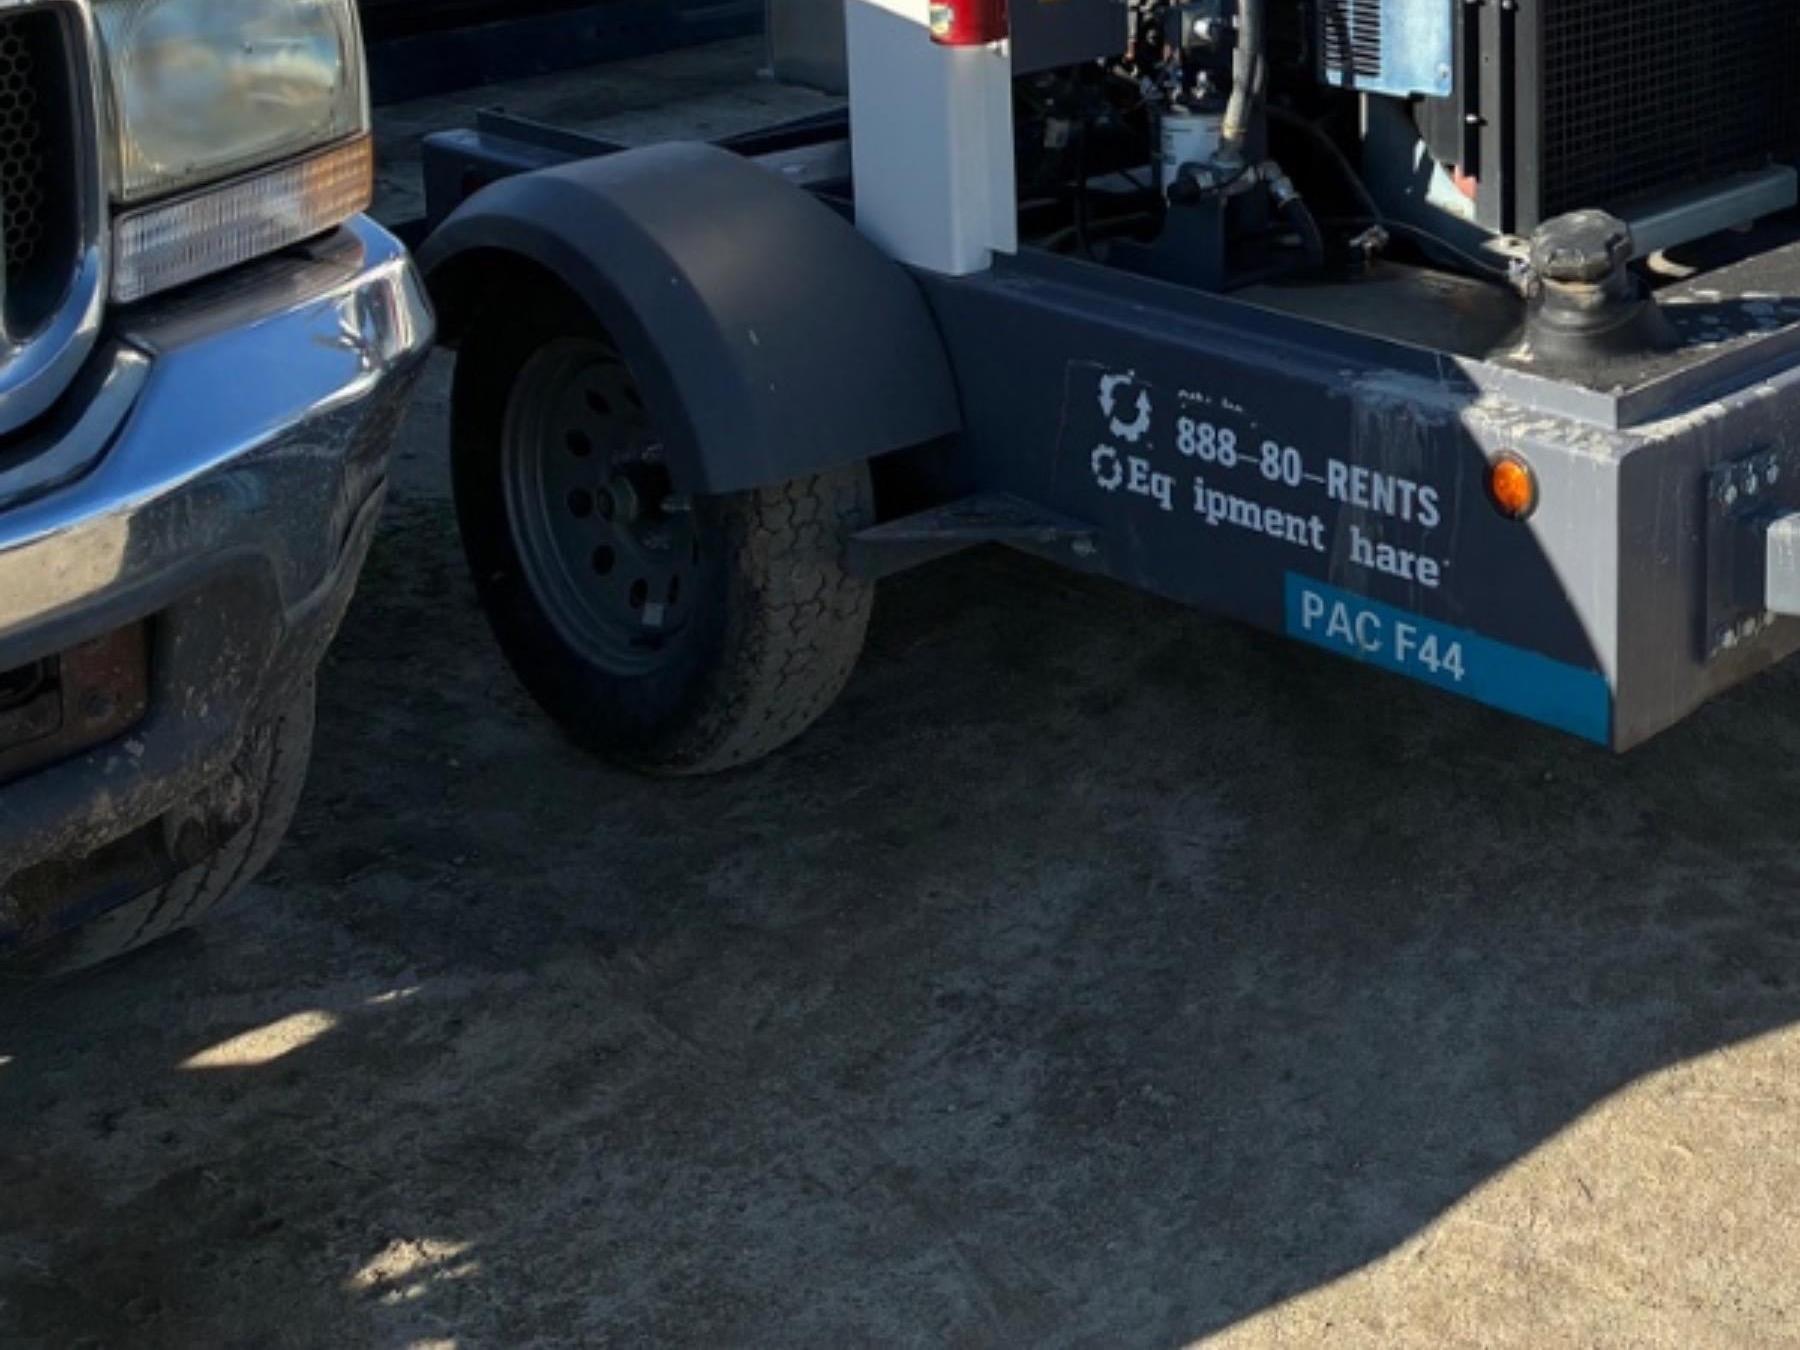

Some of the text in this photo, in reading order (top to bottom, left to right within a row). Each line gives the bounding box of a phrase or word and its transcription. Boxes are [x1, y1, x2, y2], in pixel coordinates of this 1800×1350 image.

[1176, 415, 1441, 528] 888-80-RENTS
[1302, 590, 1465, 682] PAC F44
